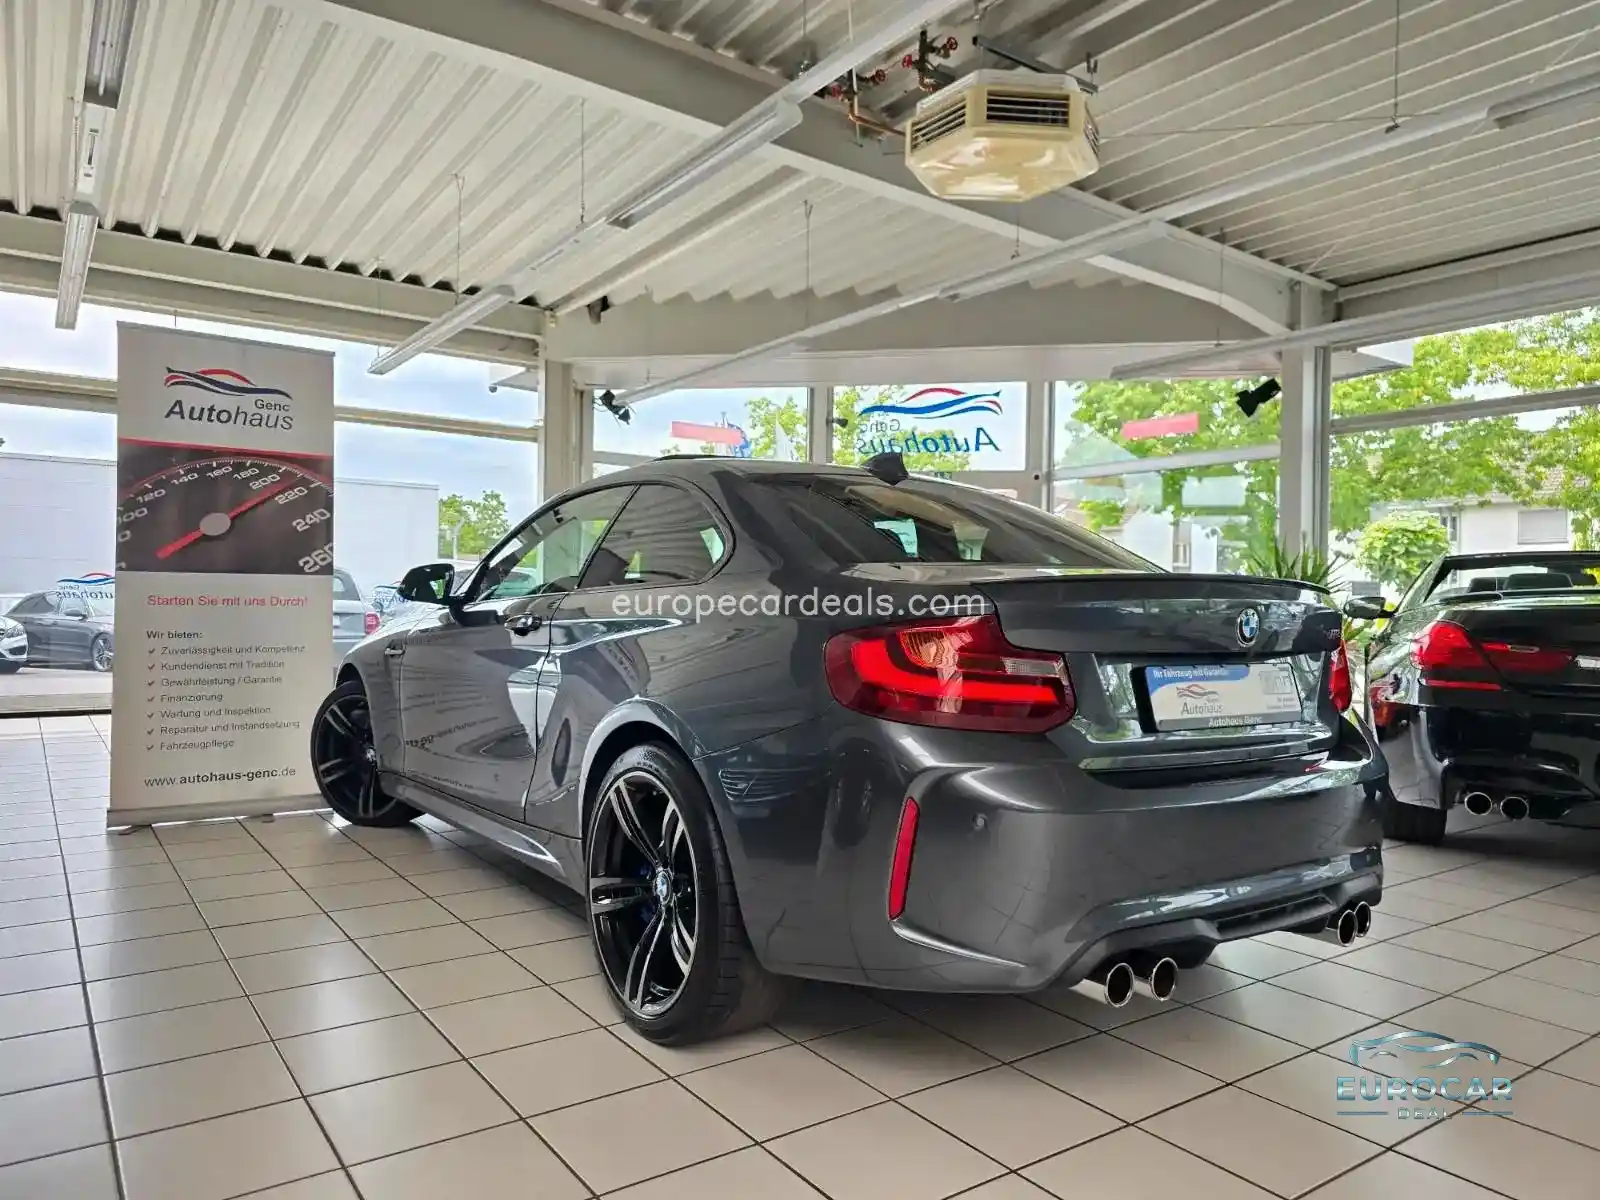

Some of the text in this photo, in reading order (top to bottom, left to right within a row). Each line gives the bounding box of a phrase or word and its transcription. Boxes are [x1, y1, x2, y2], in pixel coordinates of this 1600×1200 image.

[254, 399, 291, 412] Genc
[164, 399, 294, 431] Autohaus
[171, 473, 199, 486] 140
[206, 466, 233, 480] 160
[233, 467, 260, 481] 180
[249, 473, 281, 490] 200
[136, 489, 167, 503] 120
[275, 486, 309, 505] 220
[292, 507, 331, 532] 240
[147, 595, 308, 607] Starten Sie mit uns Durch!
[146, 629, 203, 640] Wir bieten:
[161, 662, 227, 671] Kundendienst
[229, 661, 243, 669] mit
[161, 693, 223, 703] Finanzierung
[161, 706, 271, 720] Wartung und Inspektion
[161, 725, 208, 736] Reparatur
[161, 739, 235, 750] Fahrzeugpflege
[144, 766, 296, 787] www.autohaus-genc.de
